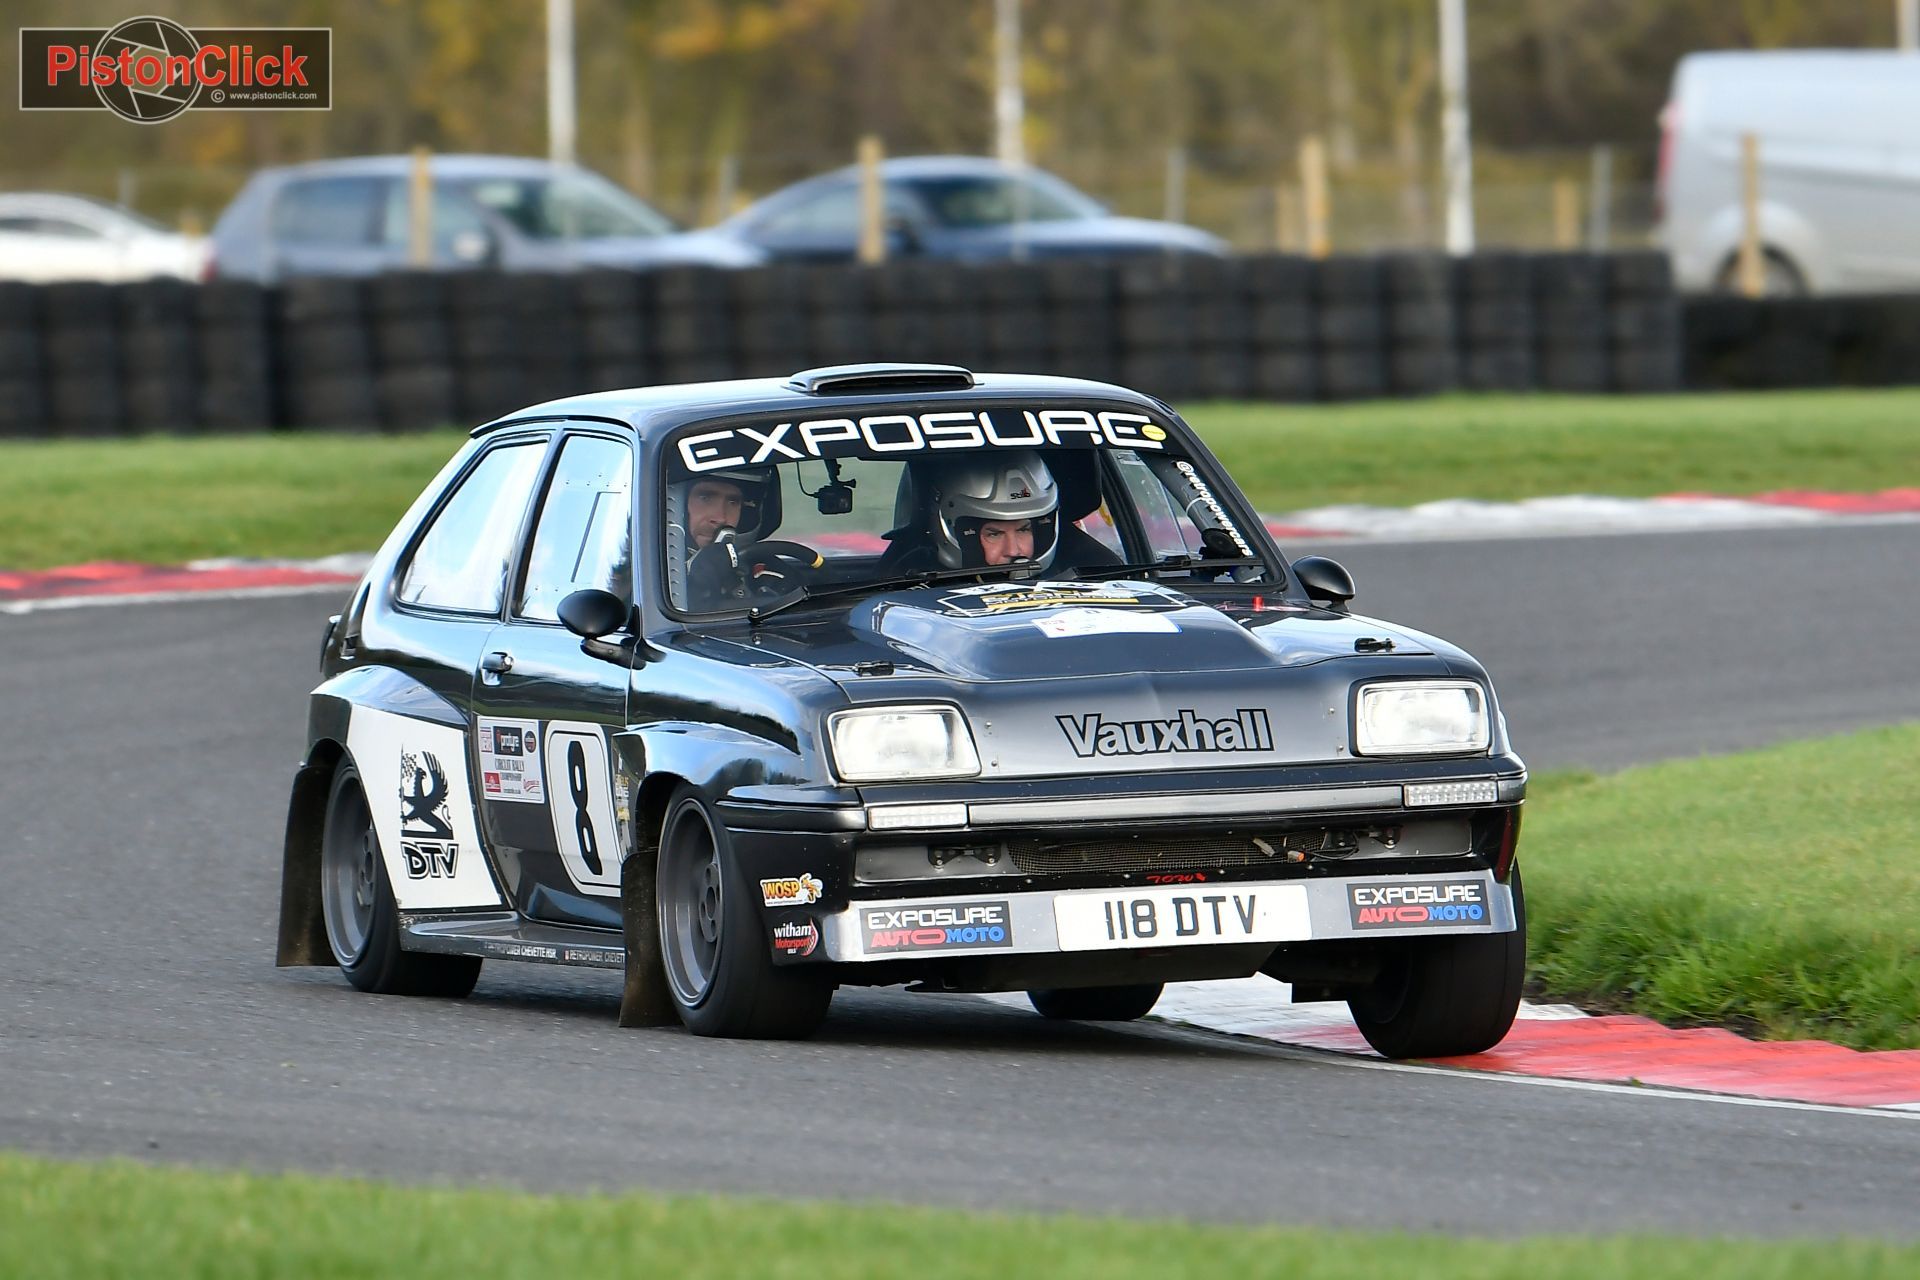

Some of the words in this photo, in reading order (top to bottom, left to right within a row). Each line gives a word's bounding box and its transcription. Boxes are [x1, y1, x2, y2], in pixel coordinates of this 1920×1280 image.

[677, 410, 1164, 473] EXPOSURE
[1055, 708, 1275, 758] Vauxhall
[567, 740, 603, 876] 8
[400, 840, 459, 880] DTV
[763, 881, 800, 899] WOSP
[1354, 884, 1482, 906] EXPOSURE
[774, 921, 811, 938] witham
[868, 905, 1003, 930] EXPOSURE
[1104, 898, 1157, 940] 118
[1172, 894, 1257, 937] DTV
